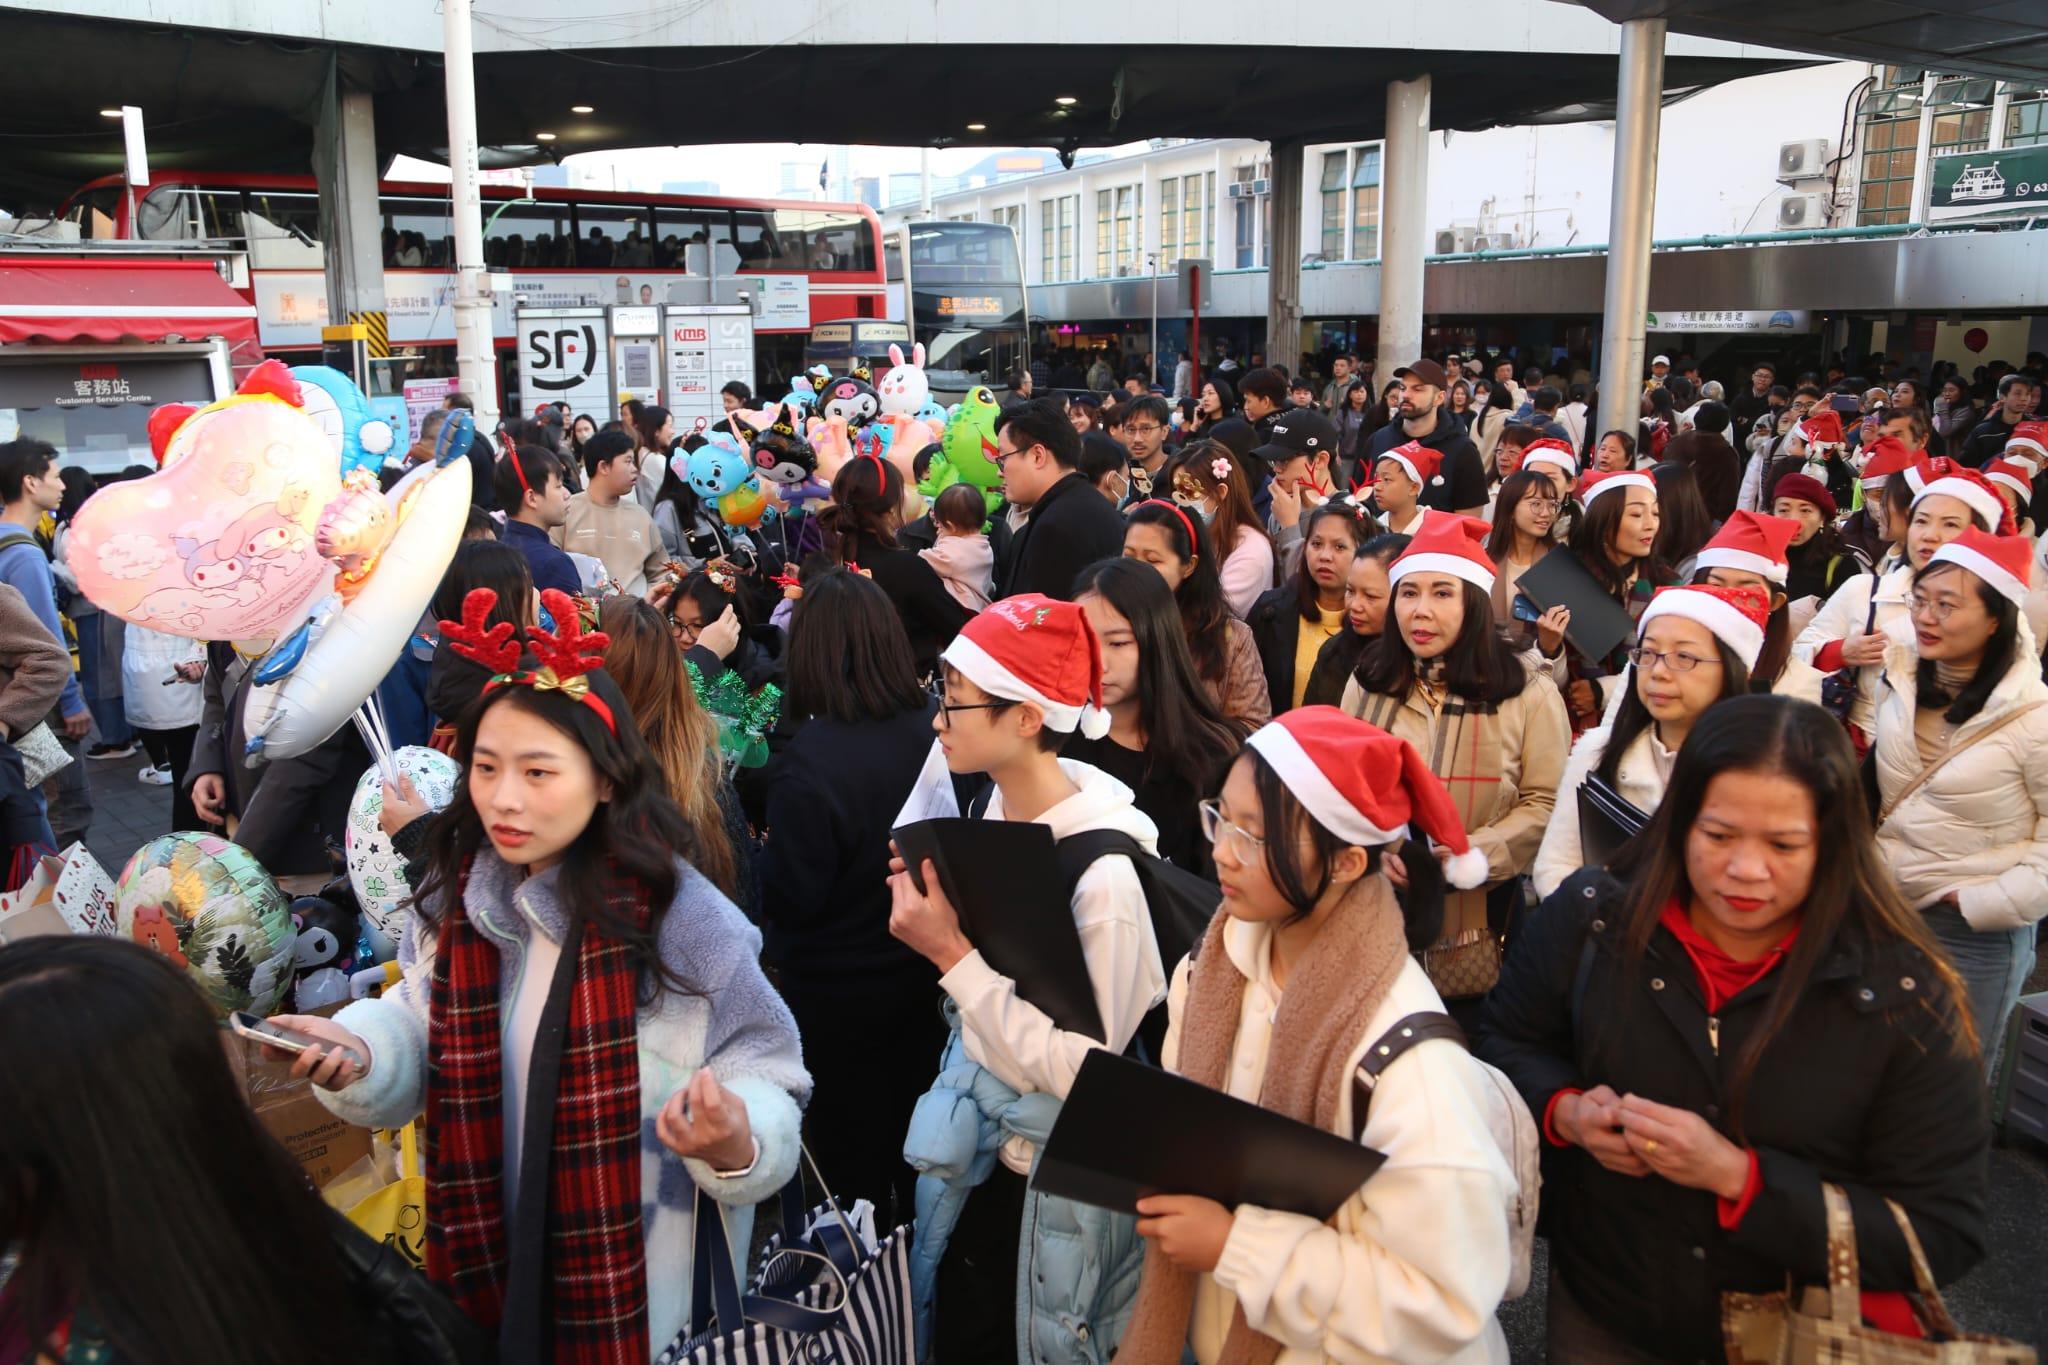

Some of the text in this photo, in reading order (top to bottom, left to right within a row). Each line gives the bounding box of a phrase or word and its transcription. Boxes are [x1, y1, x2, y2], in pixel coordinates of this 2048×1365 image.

[2033, 182, 2048, 193] 63
[73, 378, 130, 396] 客務站
[55, 394, 152, 405] Customer Service Centre
